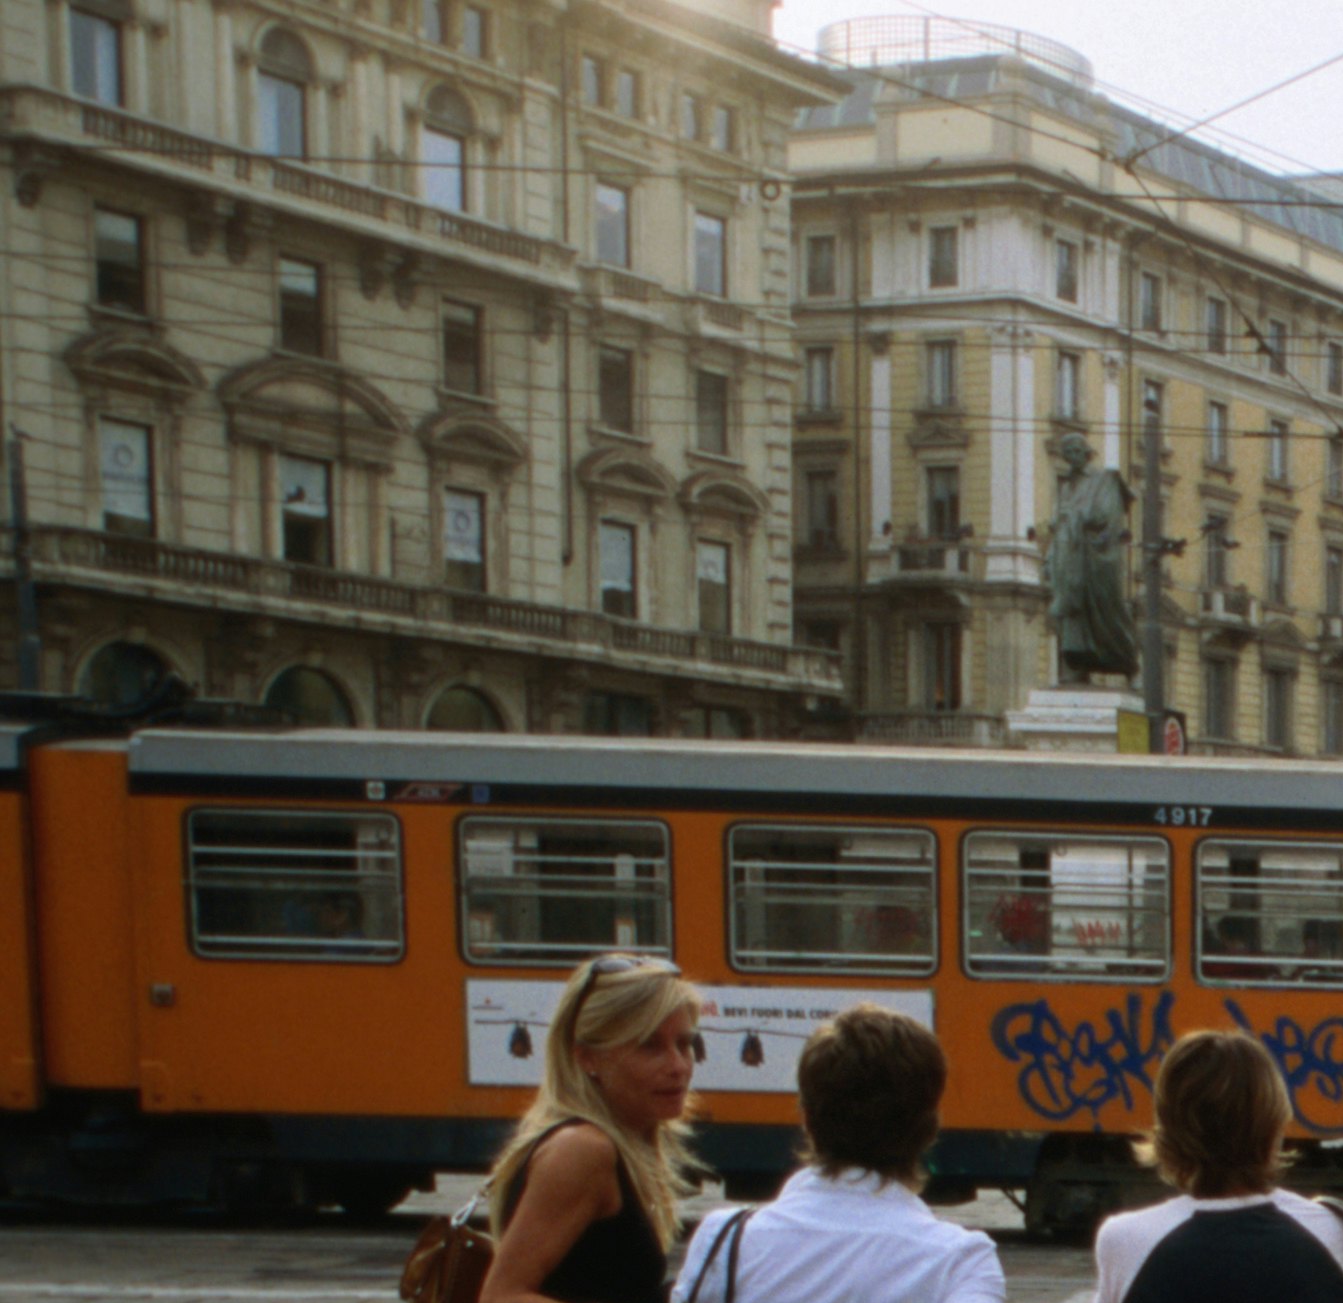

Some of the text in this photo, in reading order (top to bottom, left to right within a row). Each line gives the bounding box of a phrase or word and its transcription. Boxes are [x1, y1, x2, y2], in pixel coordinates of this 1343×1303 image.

[1153, 806, 1213, 826] 4917
[723, 1006, 748, 1018] BEVI
[751, 1007, 783, 1019] FUORI
[786, 1008, 806, 1020] DAL
